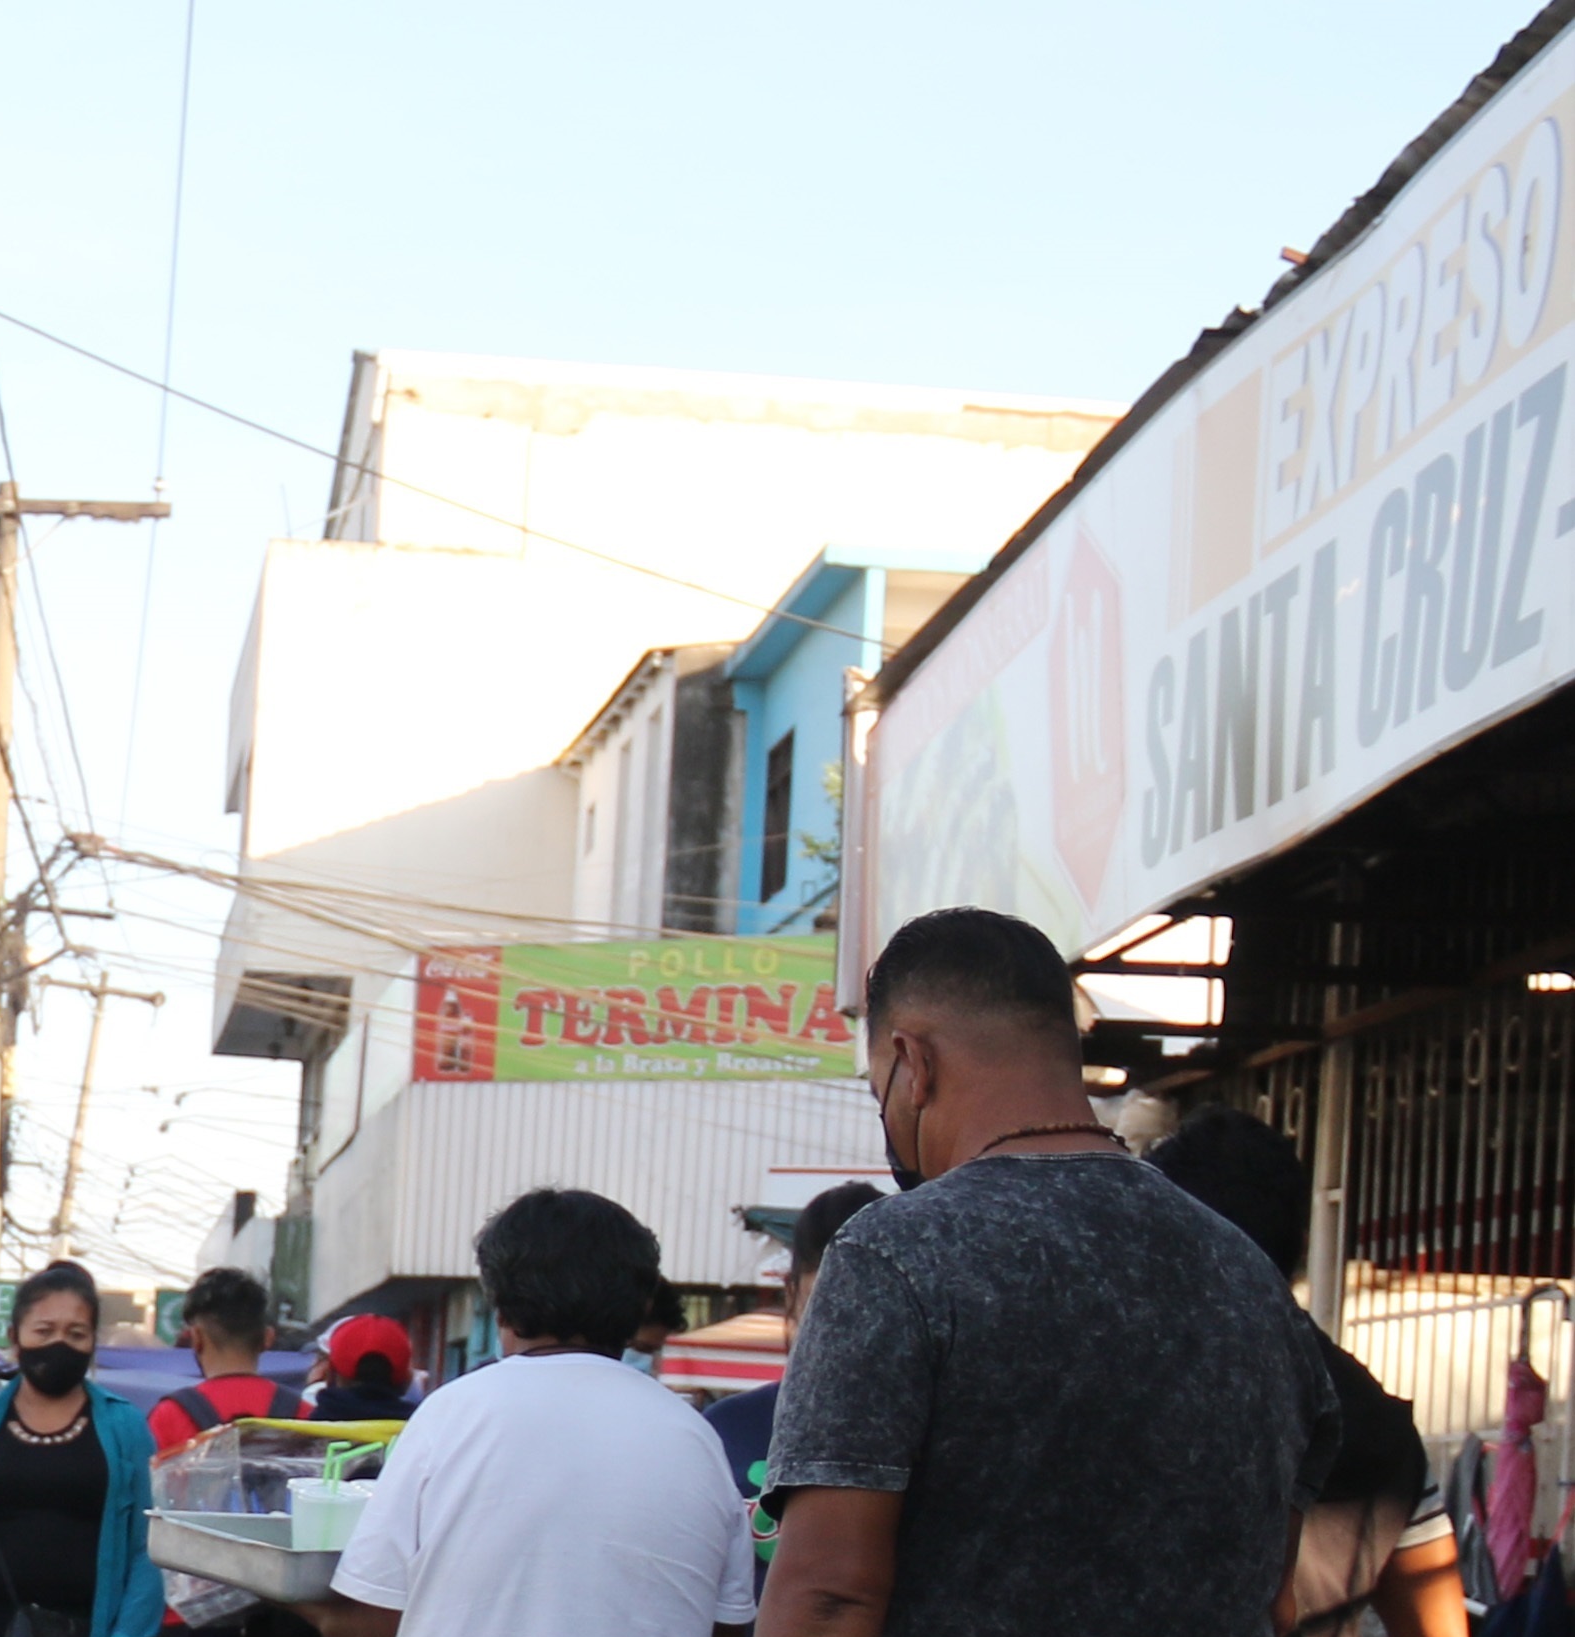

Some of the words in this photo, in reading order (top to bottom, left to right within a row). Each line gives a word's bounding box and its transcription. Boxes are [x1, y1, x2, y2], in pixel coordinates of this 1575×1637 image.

[1265, 114, 1563, 532] EXPRESO
[1140, 535, 1341, 871] SANTA
[629, 945, 781, 978] POLLO
[512, 981, 855, 1047] TERMINA
[594, 1054, 616, 1073] la
[623, 1052, 689, 1074] Brasa
[693, 1058, 709, 1077] y
